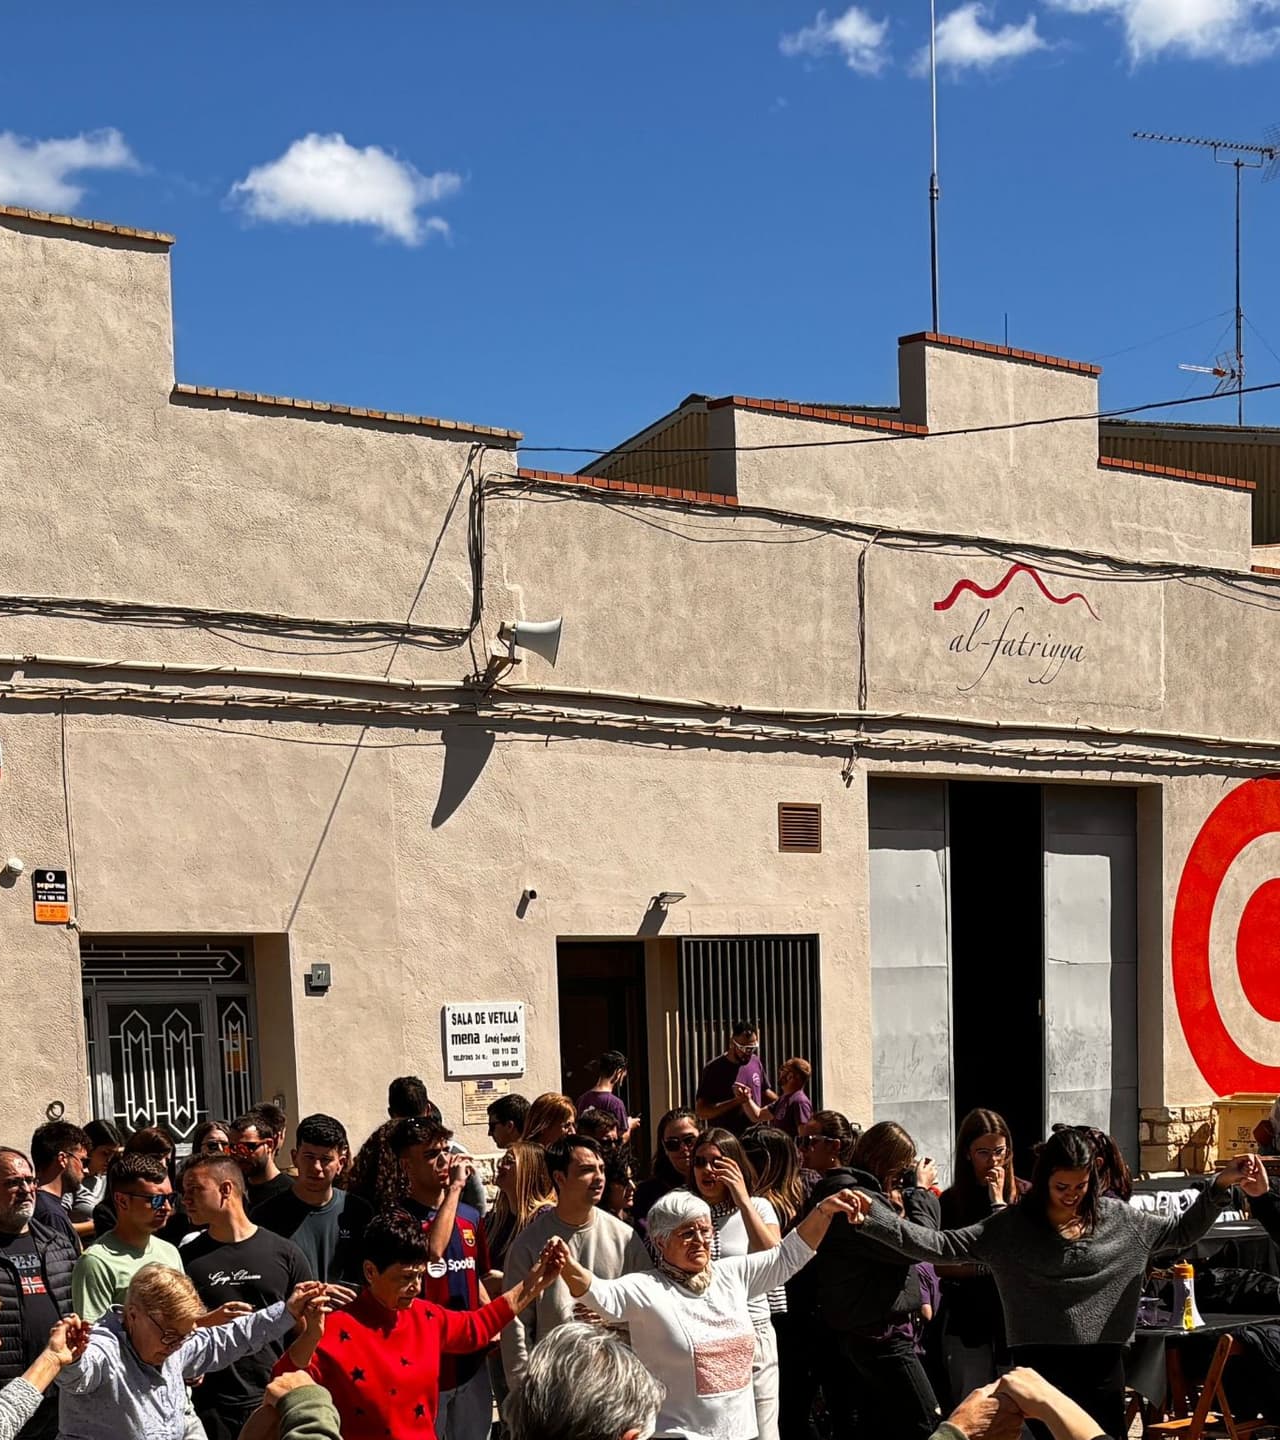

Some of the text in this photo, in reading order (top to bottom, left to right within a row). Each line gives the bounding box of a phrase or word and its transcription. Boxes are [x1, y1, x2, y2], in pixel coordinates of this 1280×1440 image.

[949, 607, 1087, 691] al-fatriyya
[451, 1011, 518, 1026] SALA DE VETLLA
[451, 1033, 480, 1045] mena
